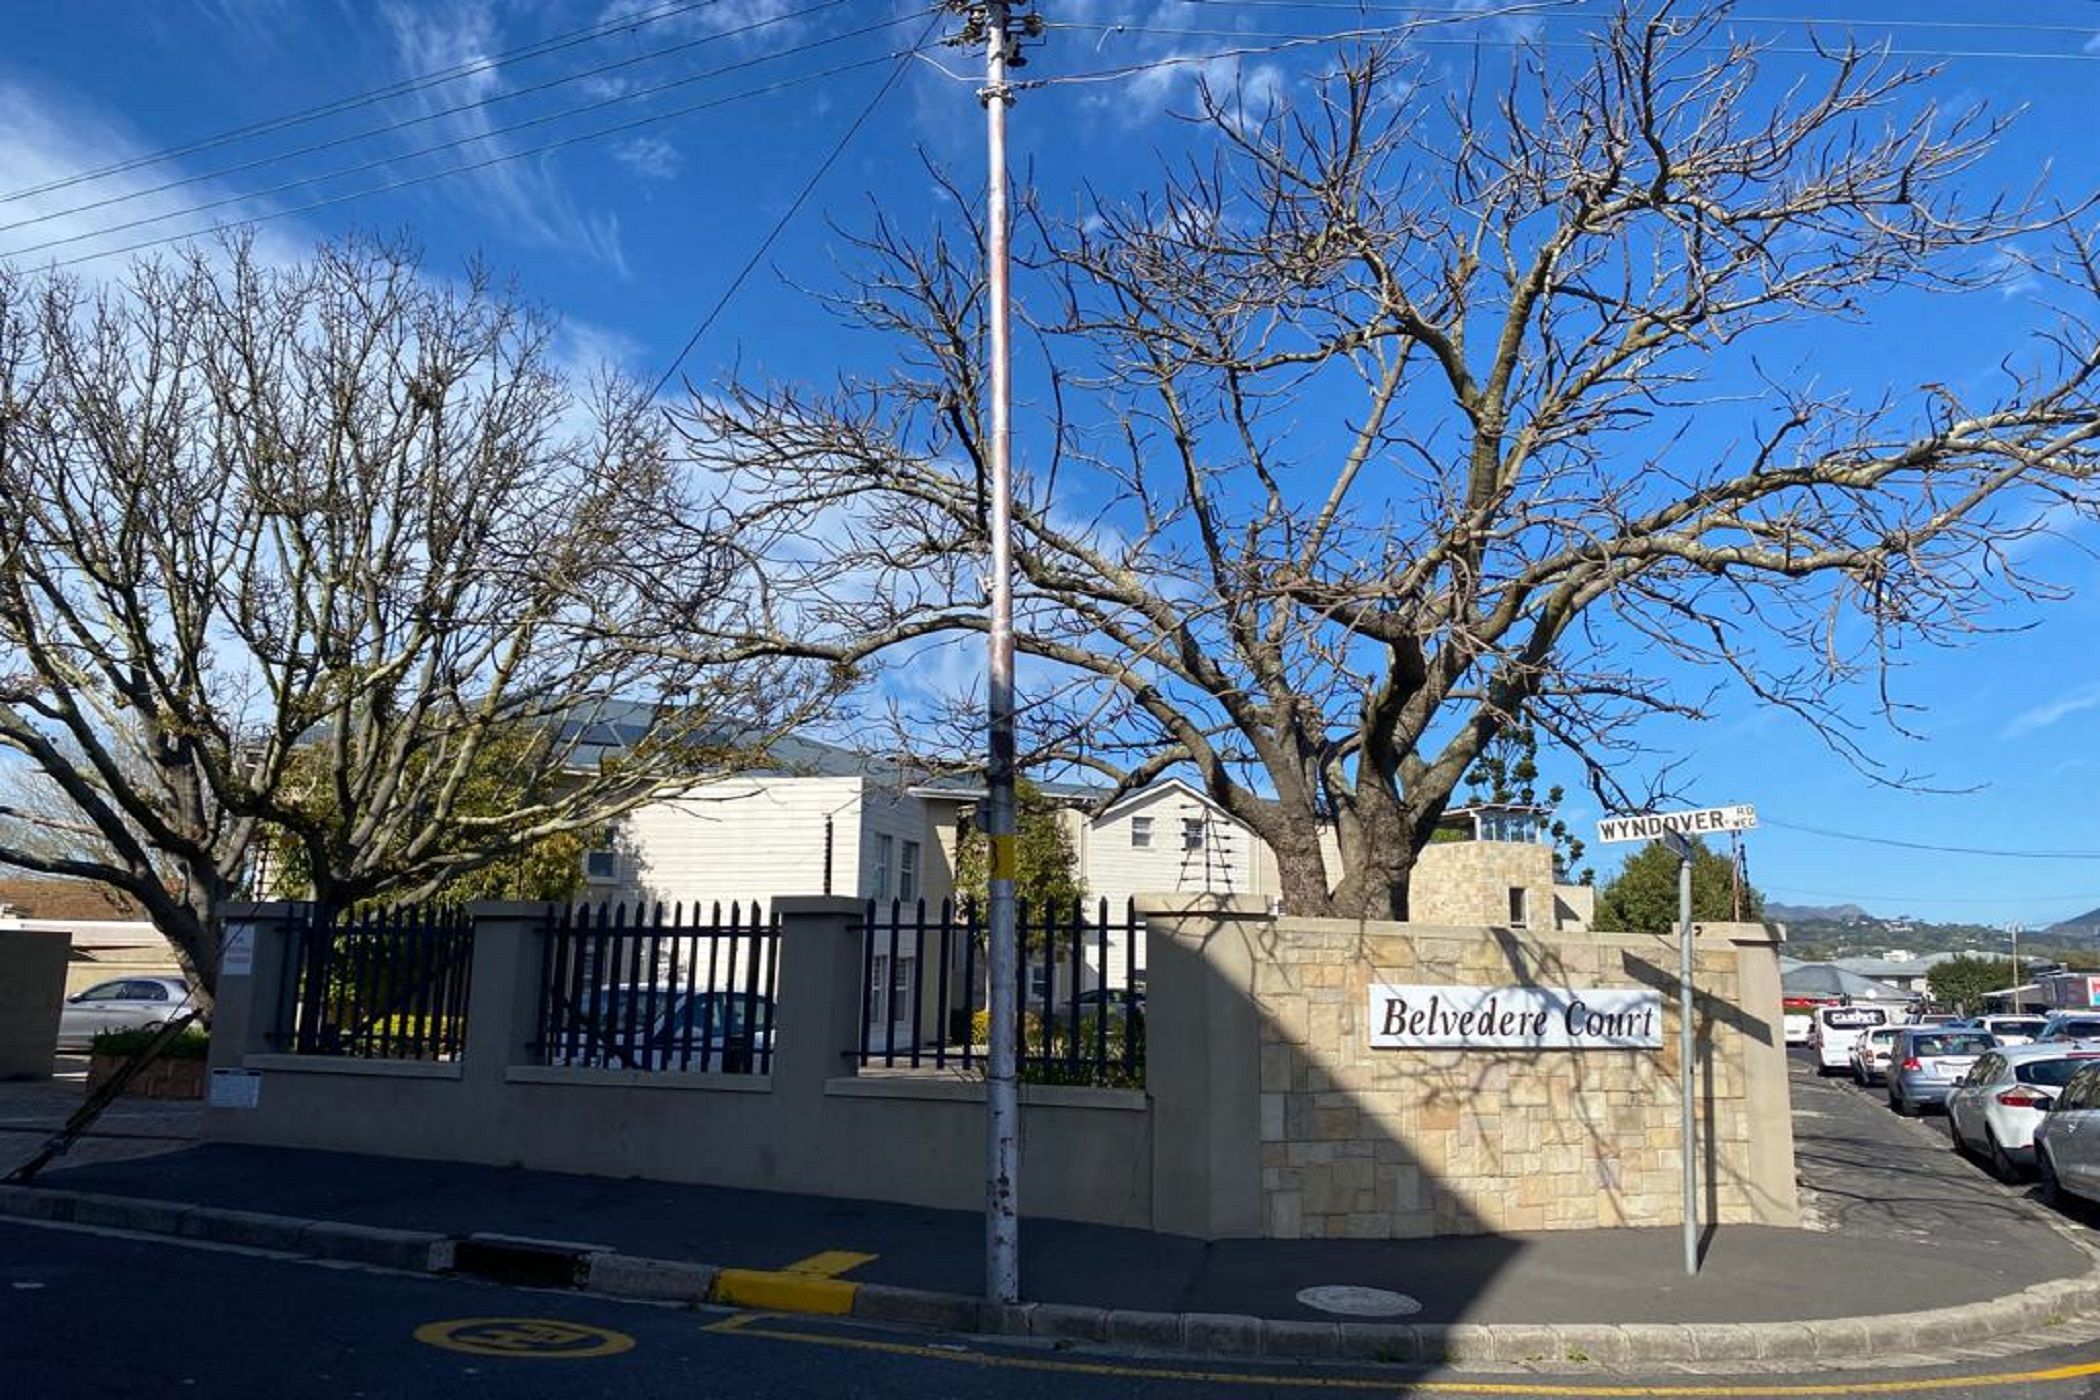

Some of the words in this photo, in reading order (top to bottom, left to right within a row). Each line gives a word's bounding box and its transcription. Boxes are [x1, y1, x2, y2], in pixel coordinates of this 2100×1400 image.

[1600, 810, 1724, 840] WYNDOVER
[1736, 806, 1754, 816] RD
[1381, 995, 1548, 1036] Belvedere
[1564, 999, 1653, 1037] Court
